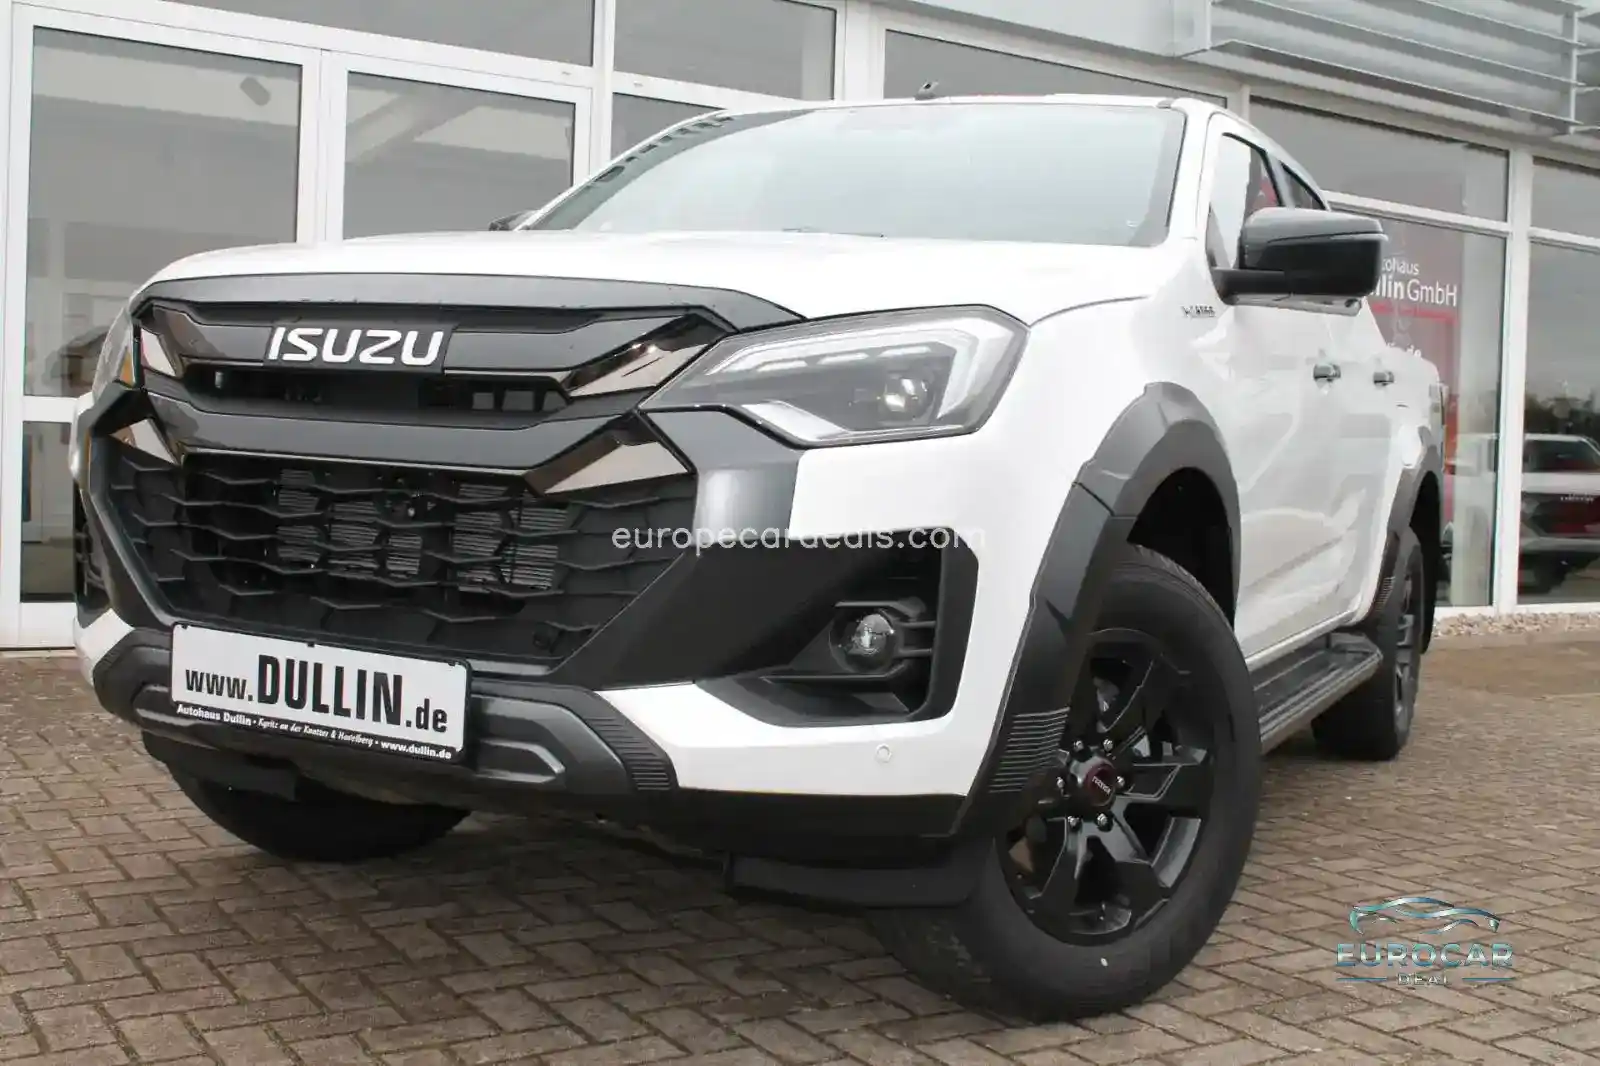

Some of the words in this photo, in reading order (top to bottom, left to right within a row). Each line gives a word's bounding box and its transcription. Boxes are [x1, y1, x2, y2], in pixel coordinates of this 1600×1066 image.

[1406, 278, 1458, 307] GmbH
[267, 326, 445, 366] ISUZU
[176, 703, 221, 721] Autohaus
[223, 711, 253, 727] Dullin
[380, 741, 452, 759] www.dullin.de
